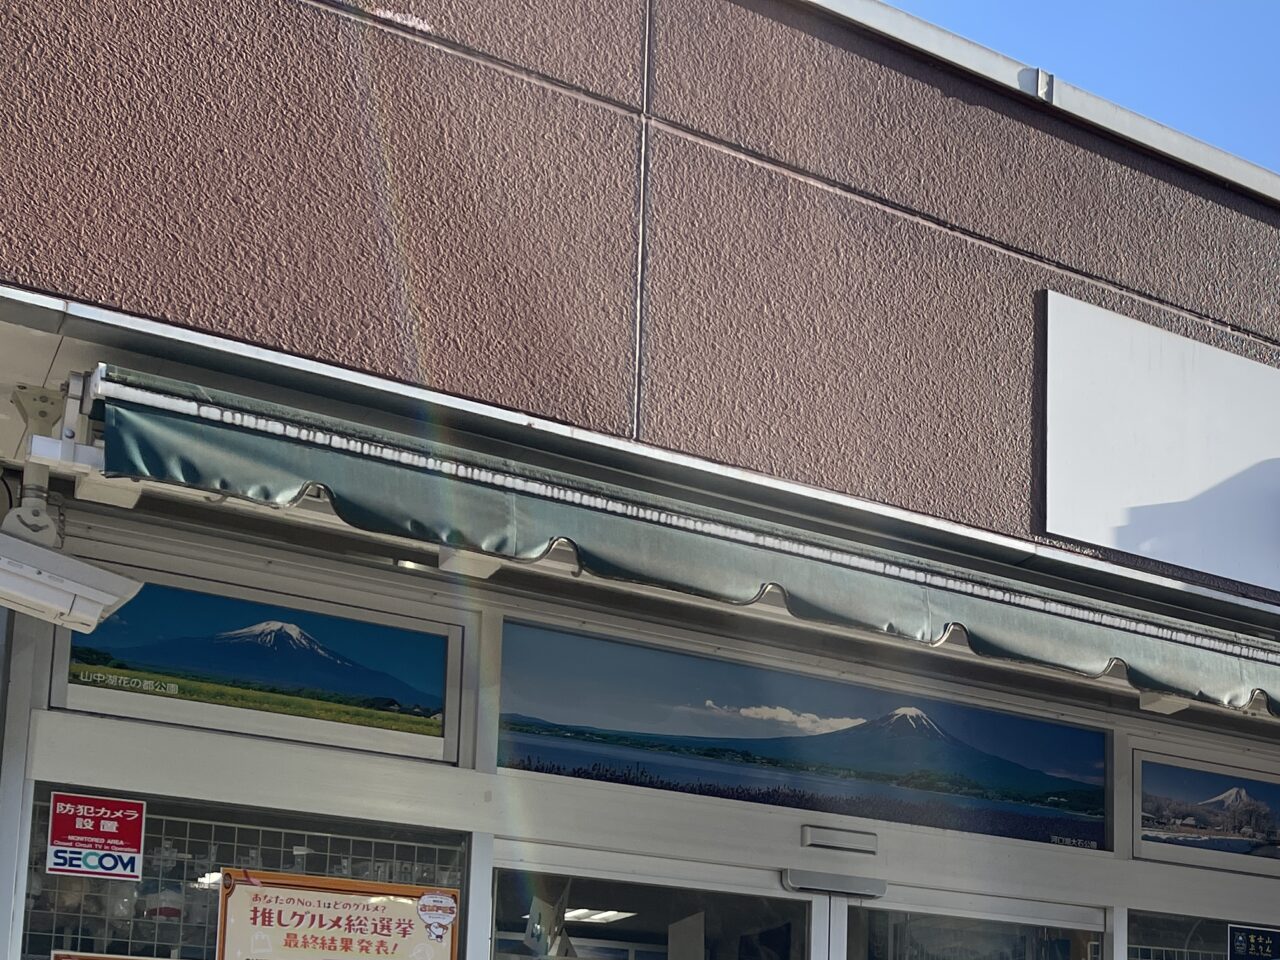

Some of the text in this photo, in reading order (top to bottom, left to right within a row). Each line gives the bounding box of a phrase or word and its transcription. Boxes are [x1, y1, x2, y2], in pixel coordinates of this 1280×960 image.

[56, 802, 139, 820] 防犯カメラ
[75, 817, 119, 832] 設置
[53, 849, 136, 873] SECOM
[249, 906, 415, 938] 推しグルメ総選挙
